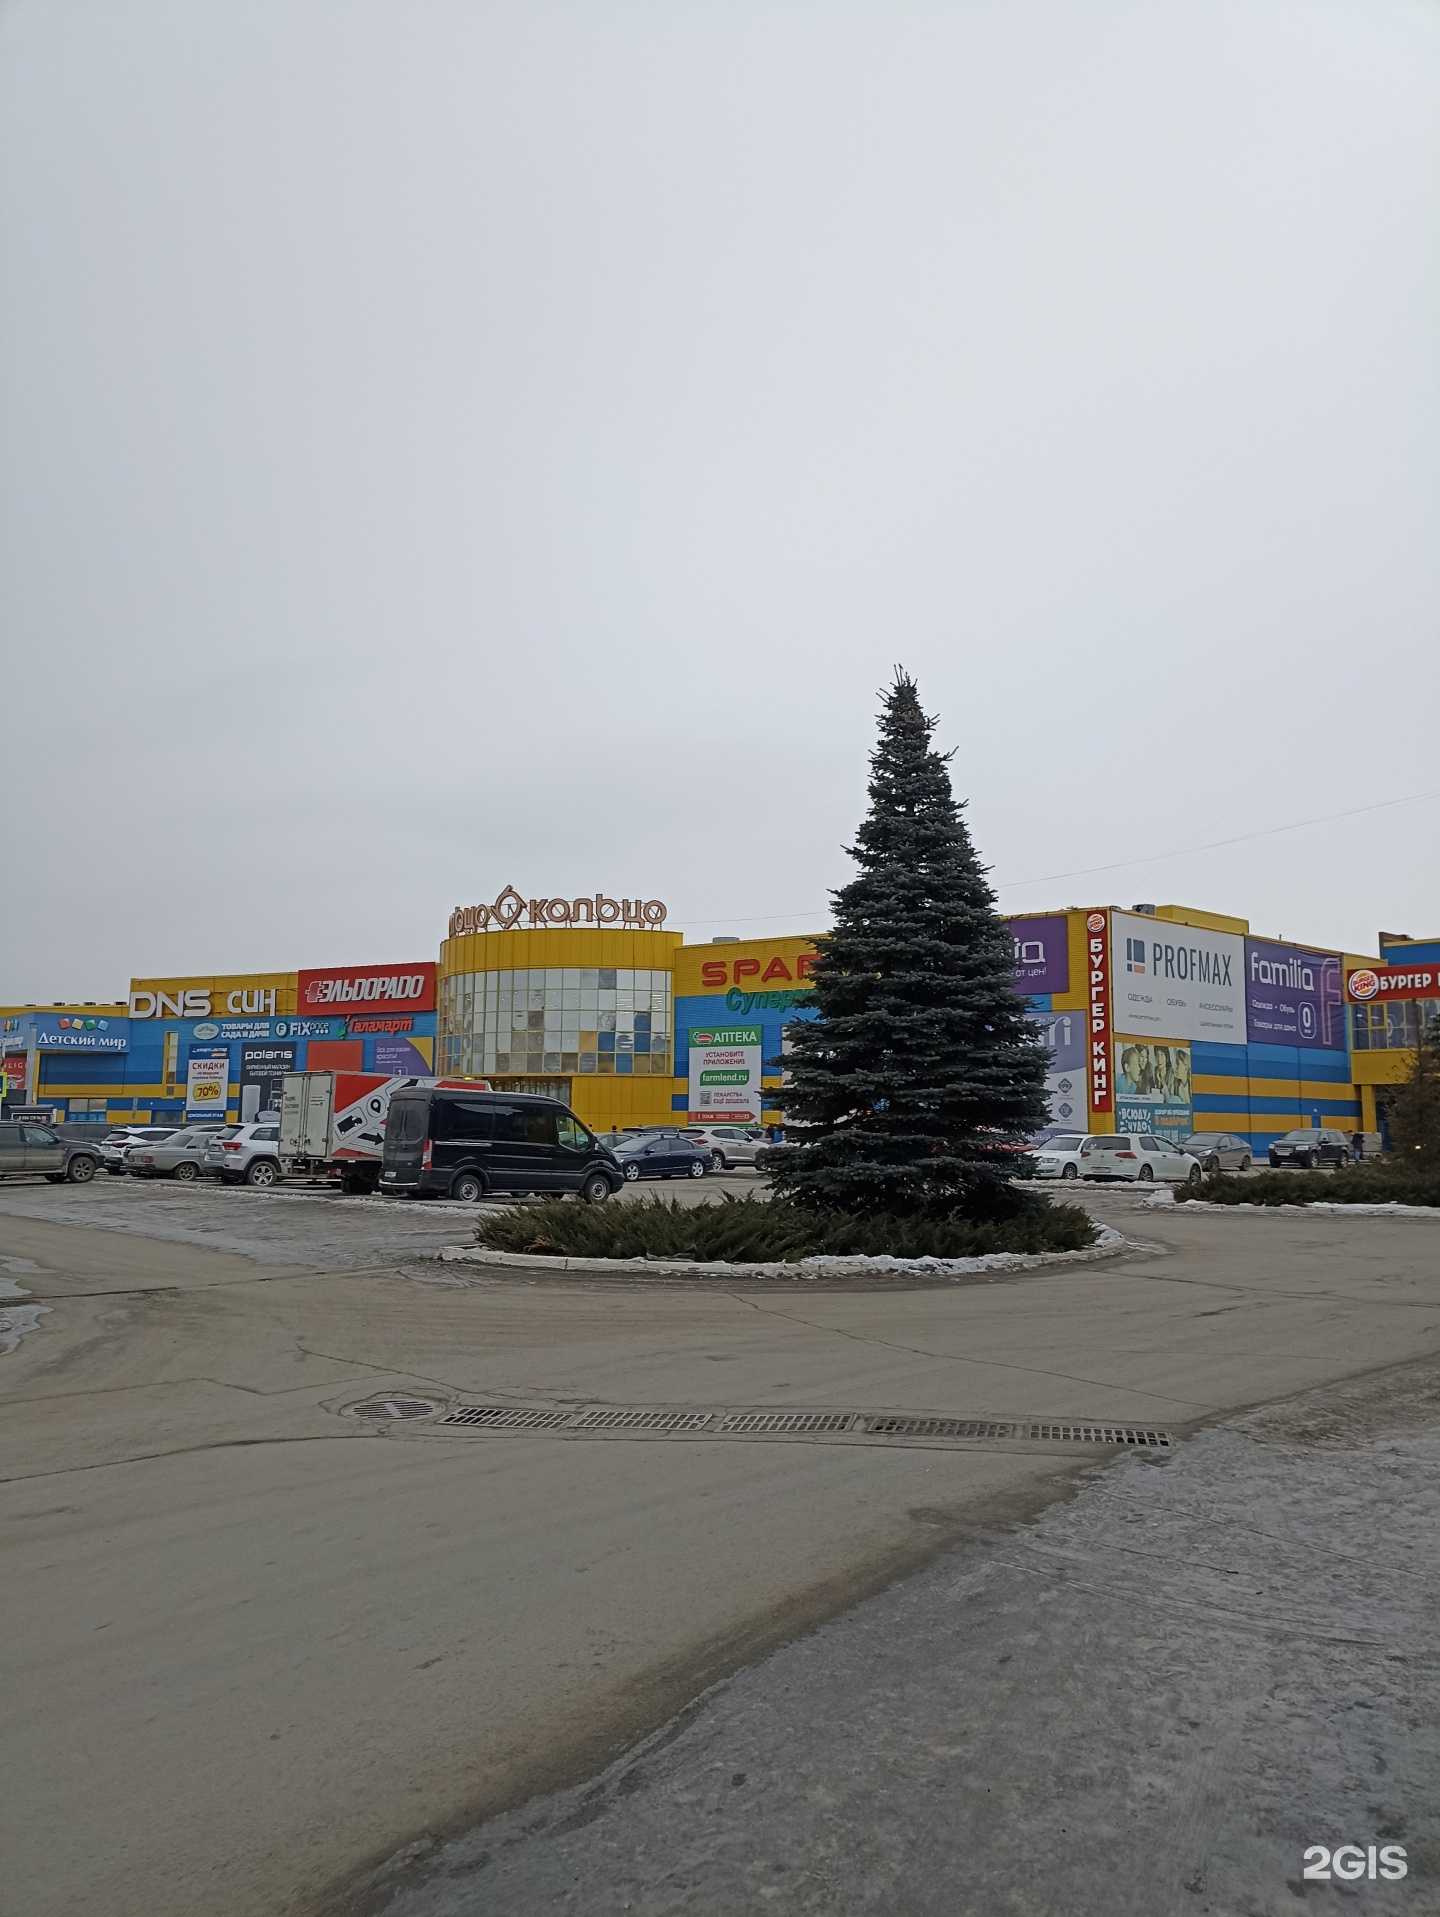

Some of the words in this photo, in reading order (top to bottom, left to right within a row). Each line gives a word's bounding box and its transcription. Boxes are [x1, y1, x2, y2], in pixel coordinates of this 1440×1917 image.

[1153, 943, 1232, 986] PROFMAX
[1251, 952, 1315, 992] familia
[1090, 938, 1105, 1032] БУРГЕР
[1380, 973, 1432, 990] БУРГЕР
[128, 989, 213, 1018] DNS
[38, 1031, 96, 1047] Детский
[98, 1036, 127, 1049] мир
[713, 1031, 758, 1043] АПТЕКА
[245, 1050, 293, 1060] polaris
[192, 1062, 225, 1070] СКИДКИ
[1093, 1042, 1107, 1105] КИНГ
[197, 1086, 219, 1097] 70%
